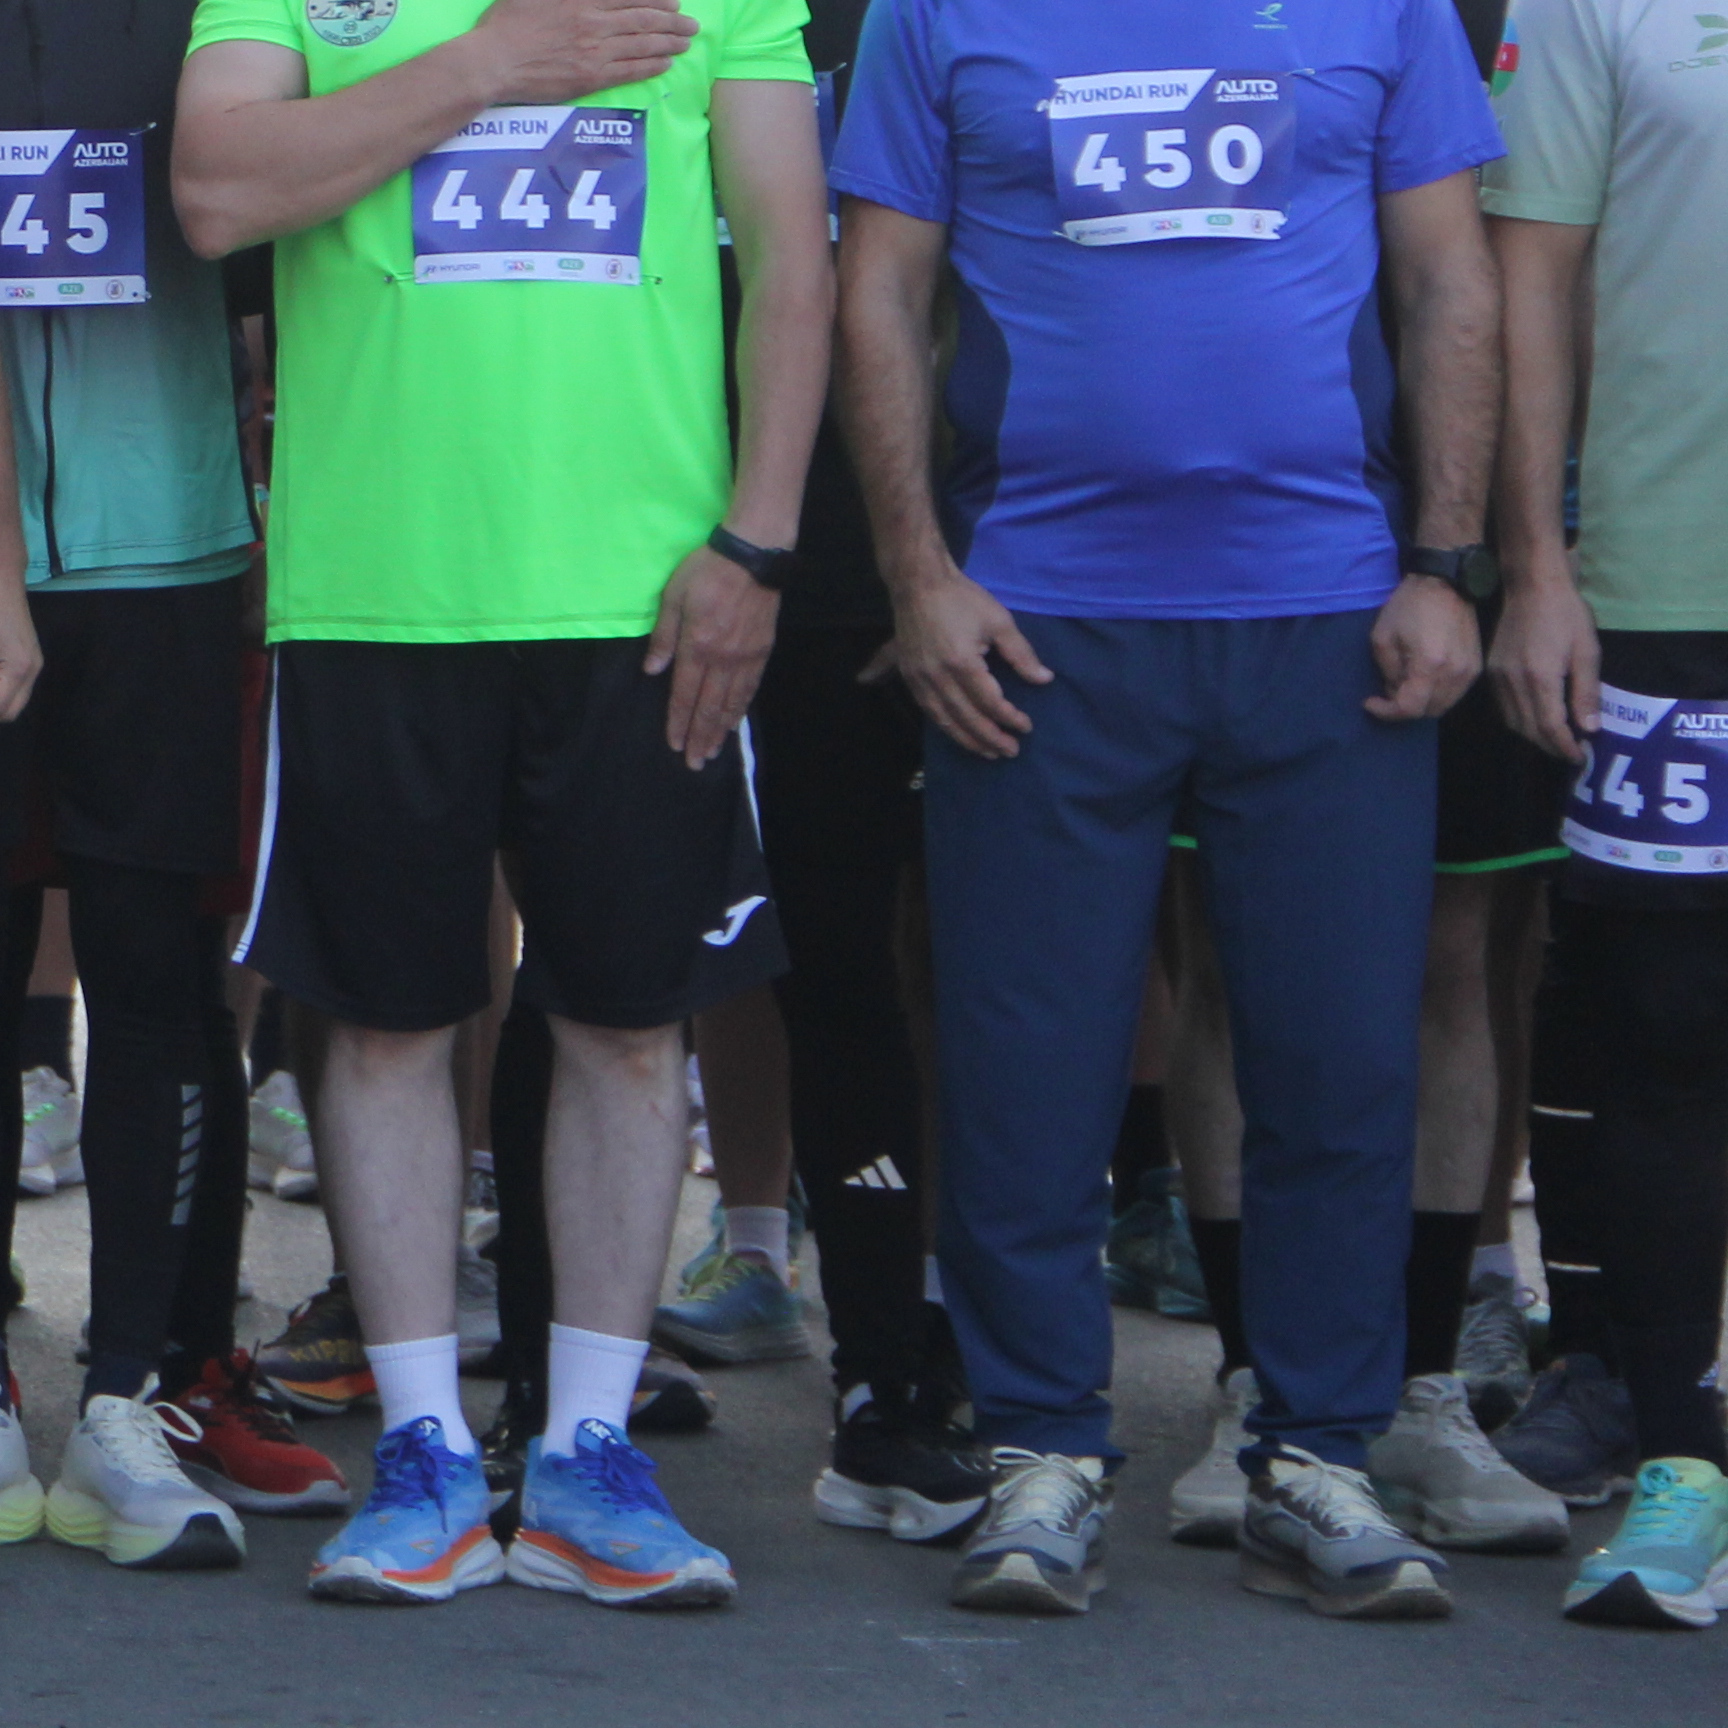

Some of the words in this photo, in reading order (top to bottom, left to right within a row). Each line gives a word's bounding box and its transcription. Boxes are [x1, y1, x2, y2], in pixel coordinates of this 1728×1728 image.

[1055, 85, 1143, 105] HYUNDAI
[1149, 82, 1188, 98] RUN
[1215, 79, 1278, 94] AUTO
[458, 120, 503, 136] NDAI
[509, 120, 549, 135] RUN
[574, 119, 633, 135] AUTO
[11, 145, 49, 161] RUN
[73, 142, 129, 159] AUTO
[1074, 124, 1263, 192] 450
[432, 168, 617, 230] 444
[1617, 704, 1649, 725] RUN
[1574, 739, 1710, 824] 245
